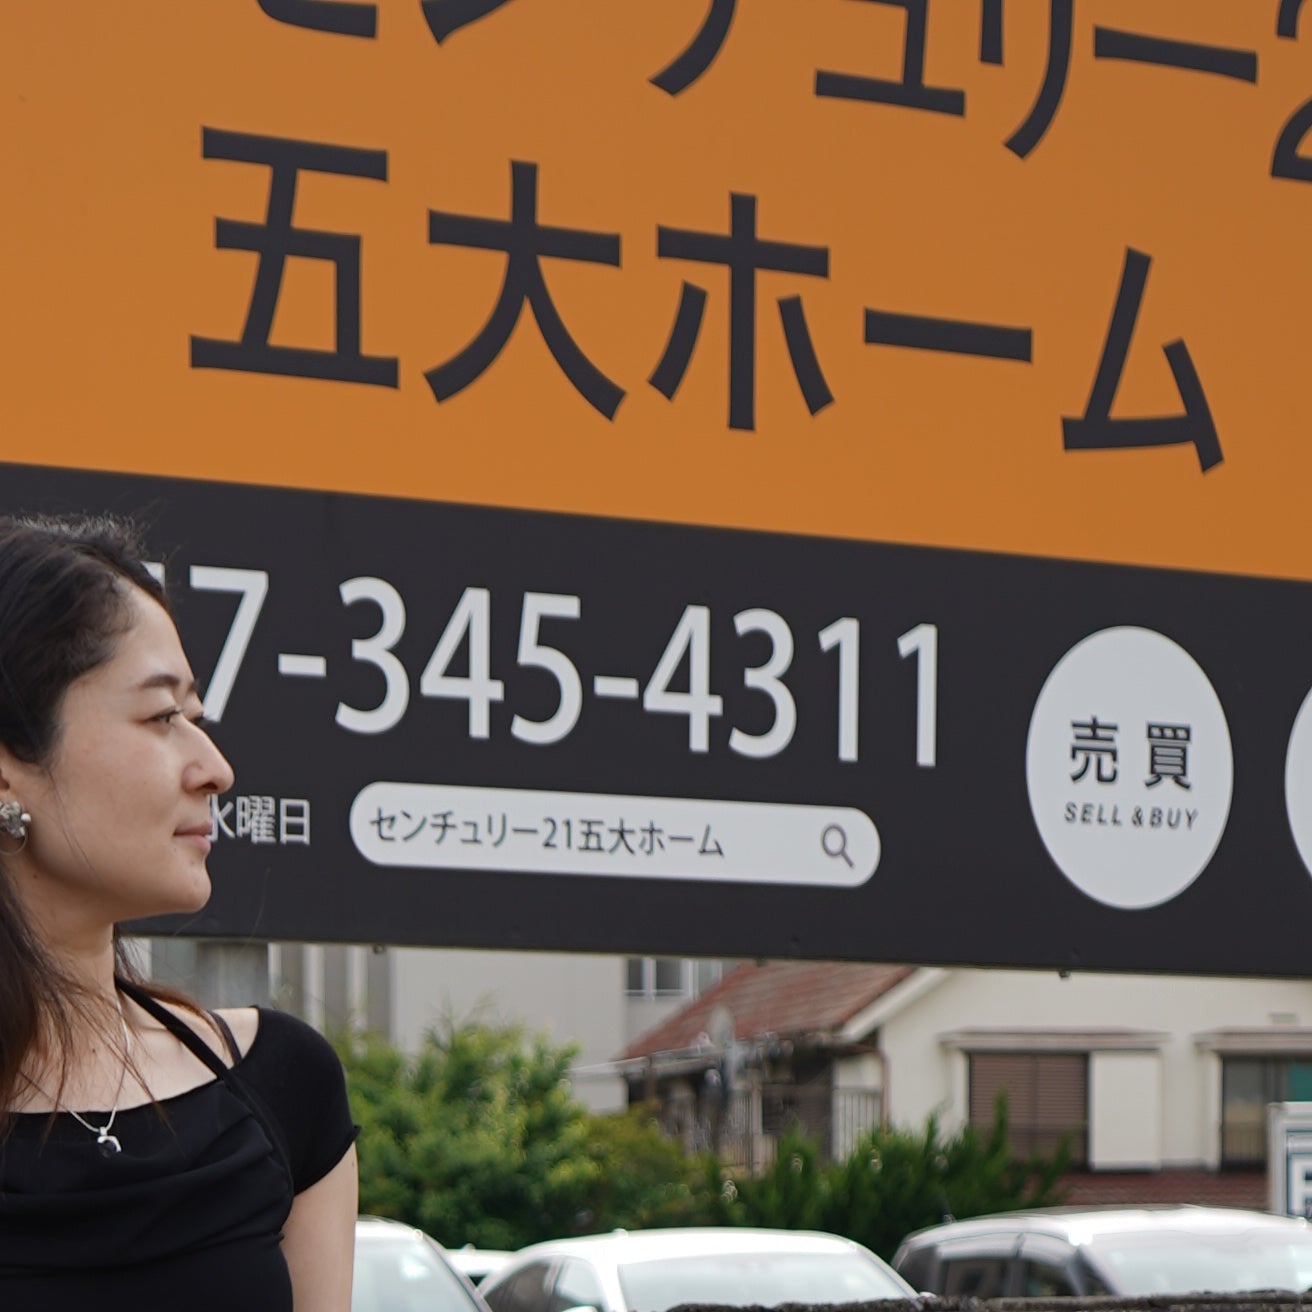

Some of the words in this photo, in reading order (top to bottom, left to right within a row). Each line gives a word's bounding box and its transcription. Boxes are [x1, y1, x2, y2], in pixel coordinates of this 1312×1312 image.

[190, 125, 1224, 474] 五大ホーム
[141, 561, 938, 767] 7-345-4311
[370, 805, 725, 859] センチュリー21五大ホーム
[1064, 802, 1122, 825] SELL
